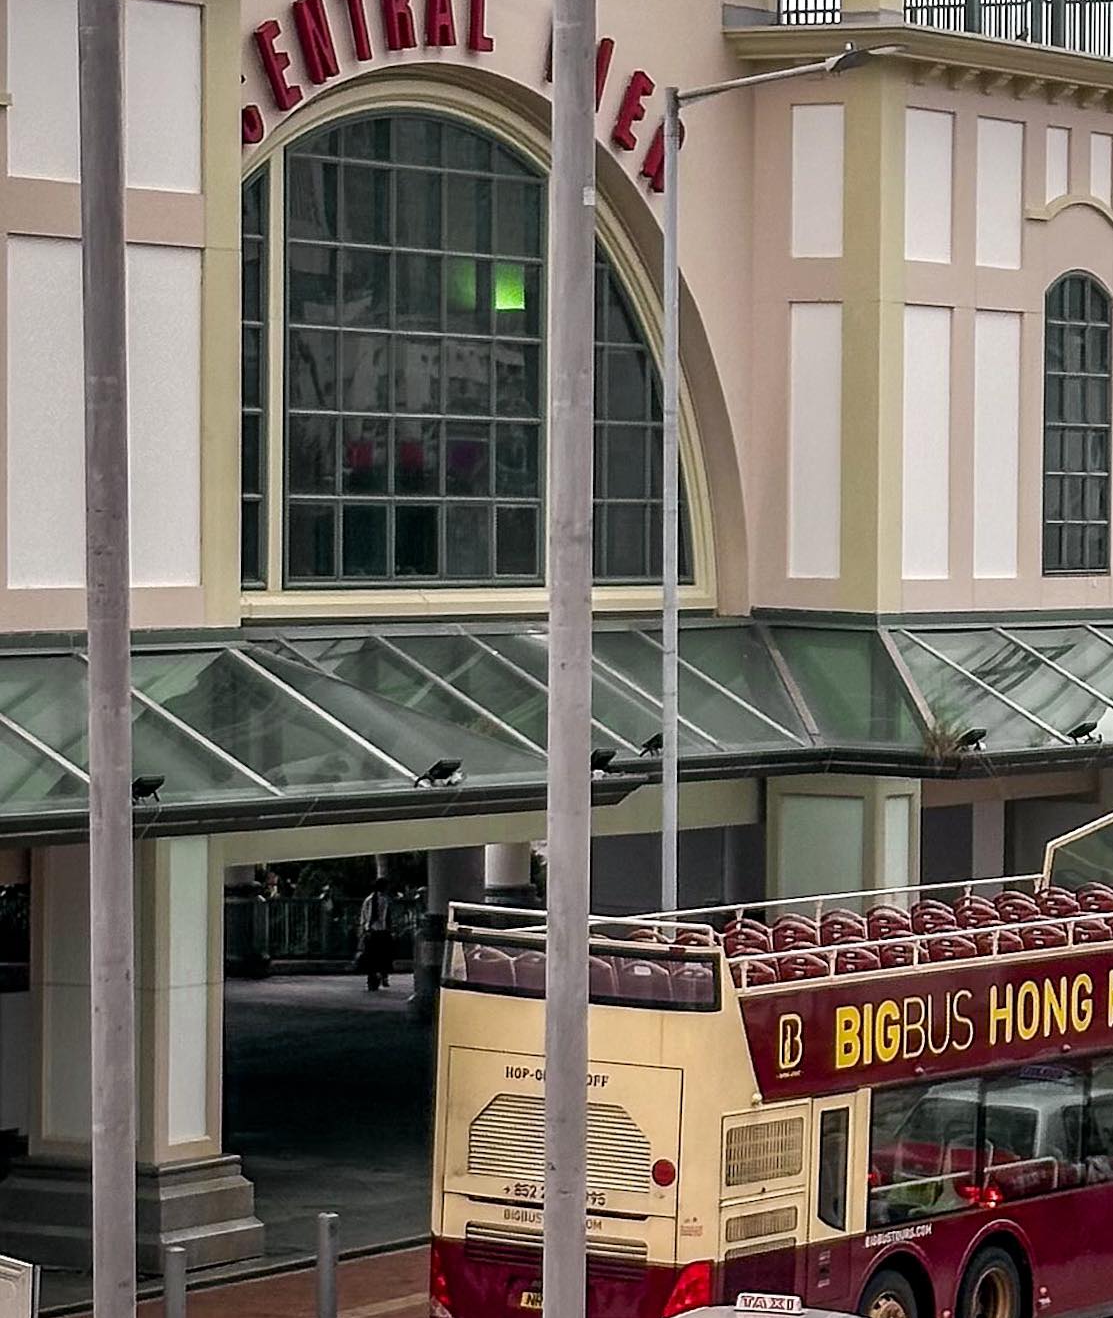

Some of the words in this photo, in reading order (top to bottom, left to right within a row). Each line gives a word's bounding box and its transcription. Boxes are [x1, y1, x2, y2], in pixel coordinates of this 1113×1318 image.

[835, 989, 974, 1070] BIGBUS
[989, 973, 1094, 1046] HONG
[505, 1065, 546, 1084] HOP-O
[742, 1296, 795, 1311] TAXI
